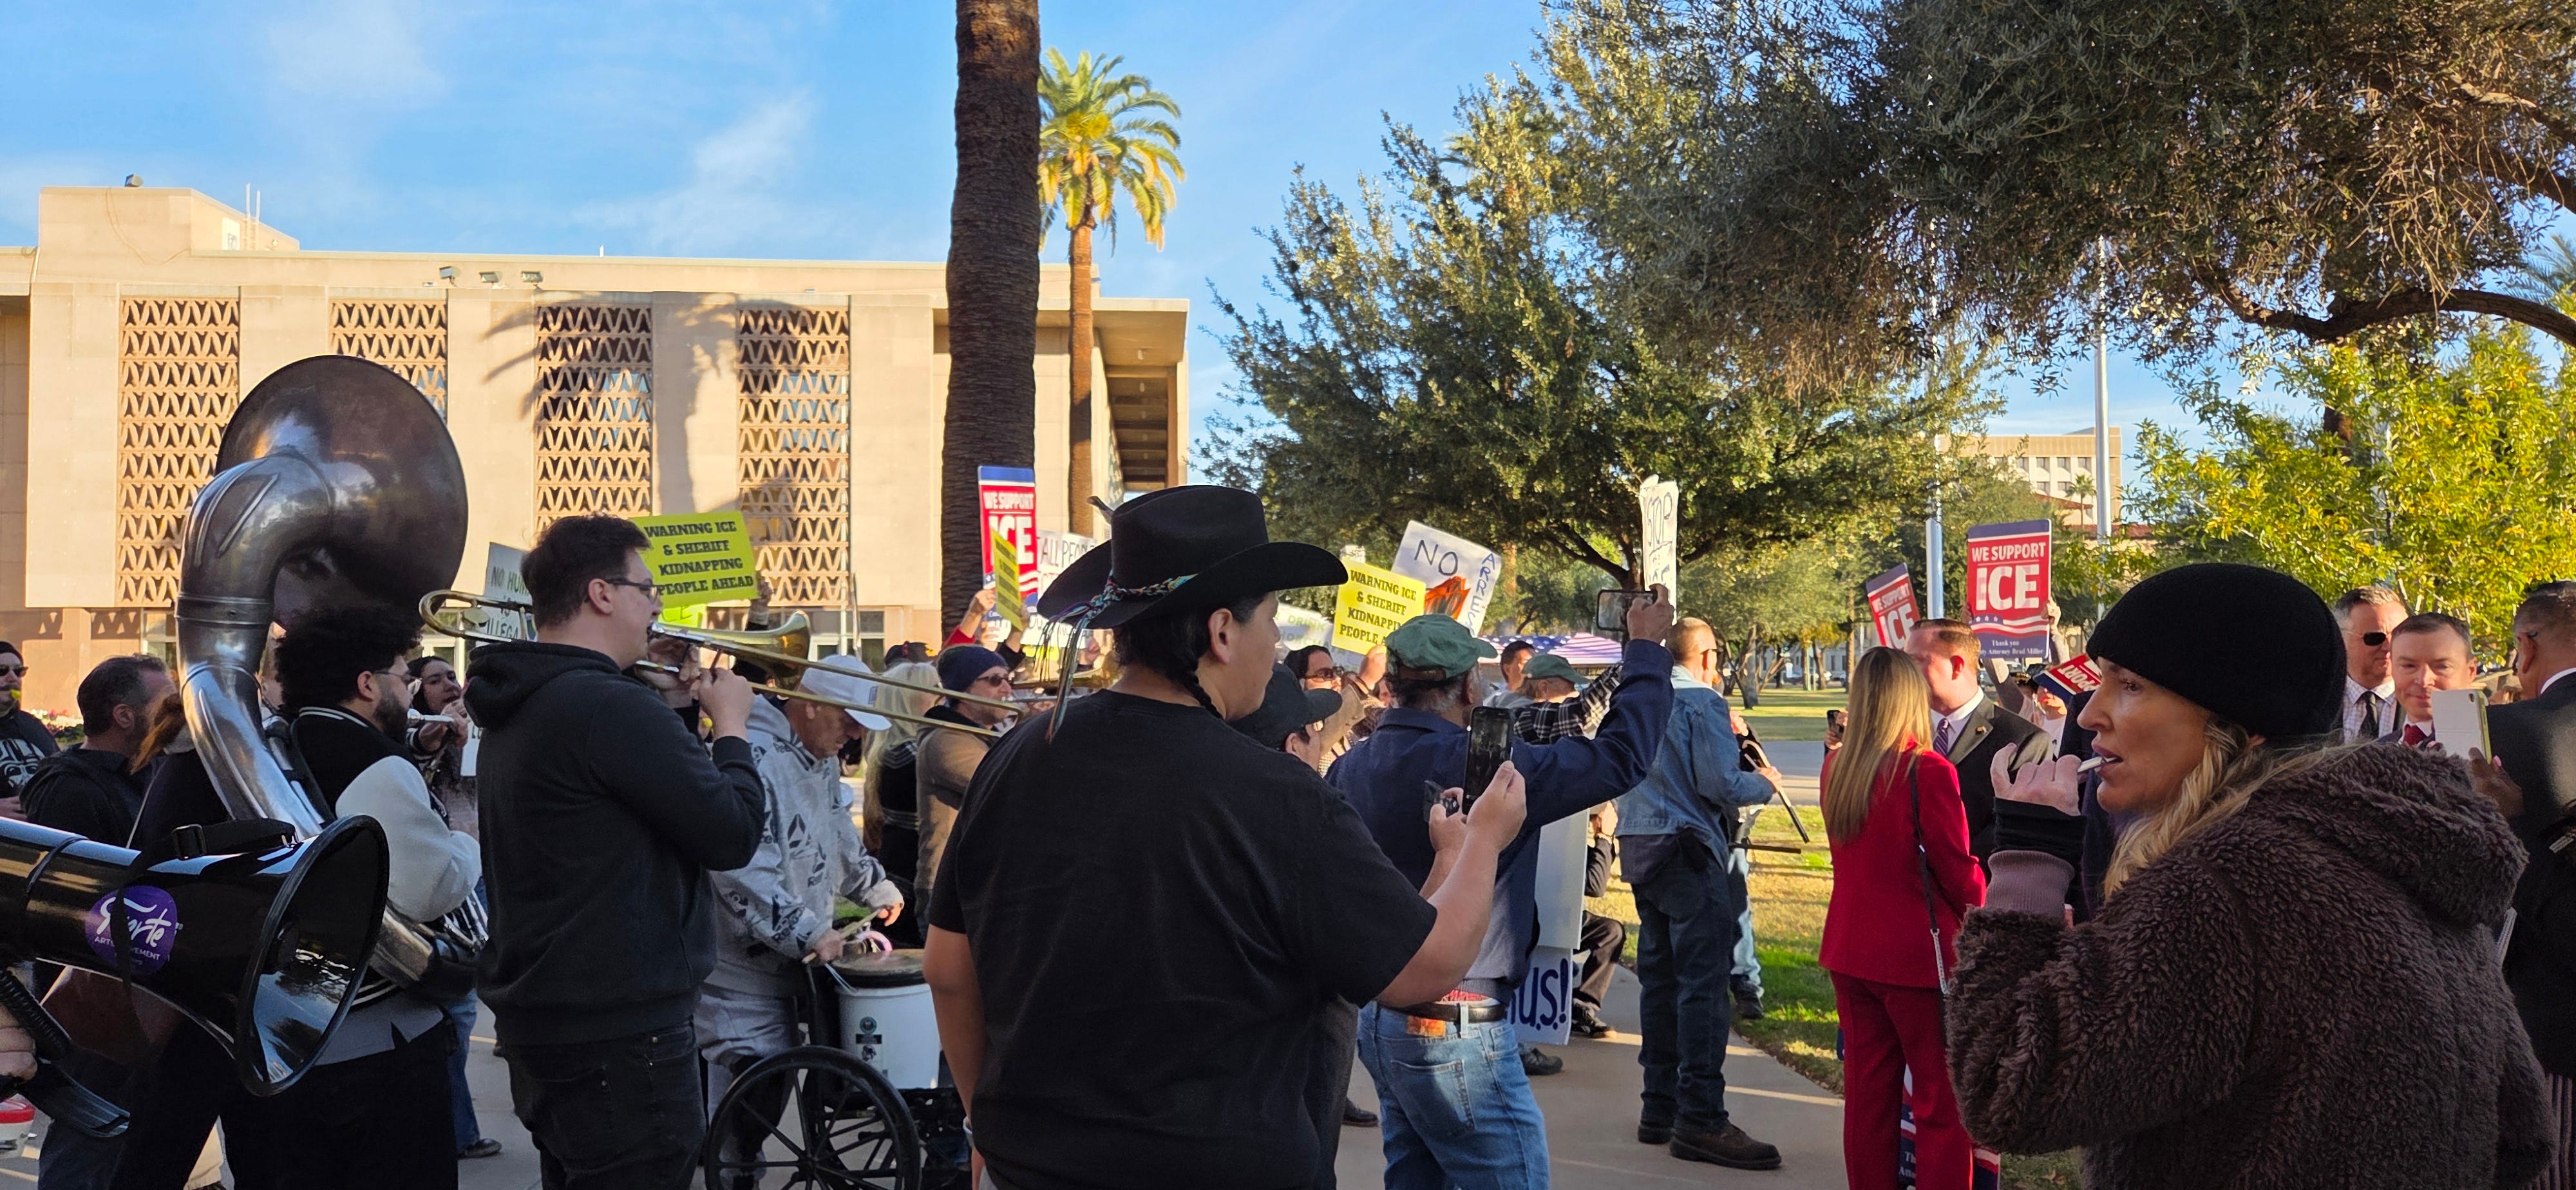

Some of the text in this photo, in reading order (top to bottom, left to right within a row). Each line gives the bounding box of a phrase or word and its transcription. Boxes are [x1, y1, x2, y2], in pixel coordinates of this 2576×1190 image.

[983, 491, 1034, 510] WE SUPPORT
[644, 521, 737, 538] WARNING ICE
[663, 540, 730, 556] & SHERIFF
[1414, 540, 1459, 576] NO
[1972, 542, 2047, 562] WE SUPPORT
[491, 566, 505, 588] NO
[658, 558, 743, 576] KIDNAPPING
[658, 576, 754, 596] PEOPLE AHEAD
[1350, 570, 1399, 595] WARNING
[1401, 587, 1417, 601] ICE
[1976, 563, 2040, 611] ICE
[1356, 591, 1364, 602] &
[1366, 594, 1406, 616] SHERIFF
[1347, 607, 1402, 631] KIDNAPPI
[1879, 603, 1915, 649] ICE
[1340, 623, 1379, 645] PEOPLE
